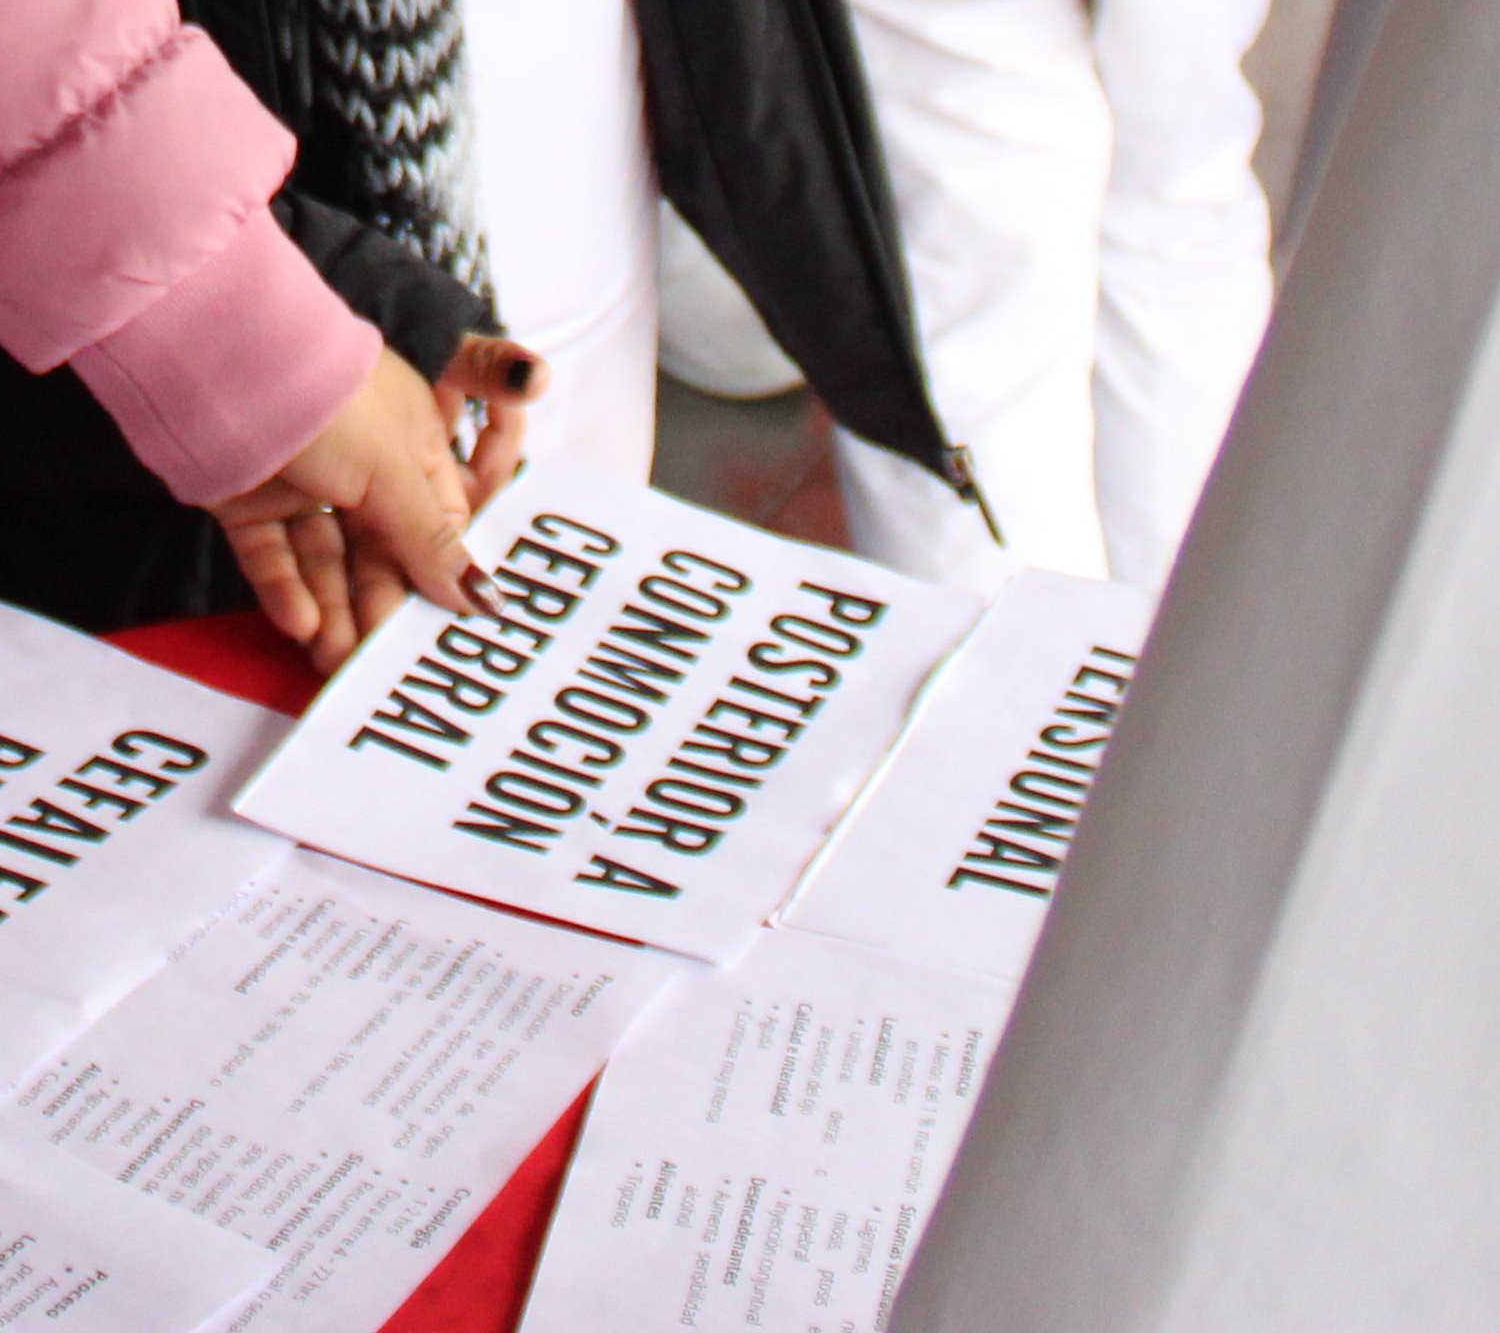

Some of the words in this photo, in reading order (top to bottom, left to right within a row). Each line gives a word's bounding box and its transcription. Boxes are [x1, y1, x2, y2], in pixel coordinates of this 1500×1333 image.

[346, 511, 623, 774] CEREBRAL
[452, 548, 754, 857] CONMOCIÓN
[604, 579, 893, 859] POSTERIOR
[573, 855, 685, 902] A
[294, 899, 336, 936] Calidad
[347, 920, 402, 979] Localización
[426, 940, 485, 1001] Prevalencia
[571, 974, 613, 1016] Proceso
[789, 1003, 813, 1045] Calidad
[869, 1017, 897, 1086] Localización
[929, 1045, 950, 1081] Menos
[956, 1030, 983, 1096] Prevalencia
[42, 1062, 102, 1116] Aliviantes
[770, 1055, 797, 1116] intensidad
[155, 1125, 212, 1180] disfunción
[218, 1134, 239, 1149] en
[308, 1153, 364, 1204] Síntomas
[368, 1189, 402, 1215] Dura
[611, 1175, 643, 1229] Triptanos
[646, 1160, 677, 1220] Aliviantes
[308, 1180, 375, 1238] Recurrente,
[341, 1216, 373, 1246] entre
[386, 1216, 413, 1235] hrs
[410, 1188, 471, 1249] Cronología
[676, 1185, 701, 1228] alcohol
[702, 1190, 731, 1243] Aumenta
[723, 1177, 767, 1286] Desencadenantes
[763, 1201, 792, 1256] Inyección
[889, 1204, 917, 1260] Síntomas
[332, 1247, 349, 1257] 4
[794, 1205, 819, 1263] palpebral
[851, 1218, 882, 1274] Lagrimeo,
[267, 1241, 315, 1291] mensual
[293, 1281, 321, 1302] hrs
[309, 1265, 335, 1282] 72
[680, 1252, 711, 1328] sensibilidad
[746, 1258, 774, 1327] conjuntival
[814, 1269, 835, 1307] ptosis
[43, 1269, 111, 1319] Proceso
[257, 1291, 271, 1300] o
